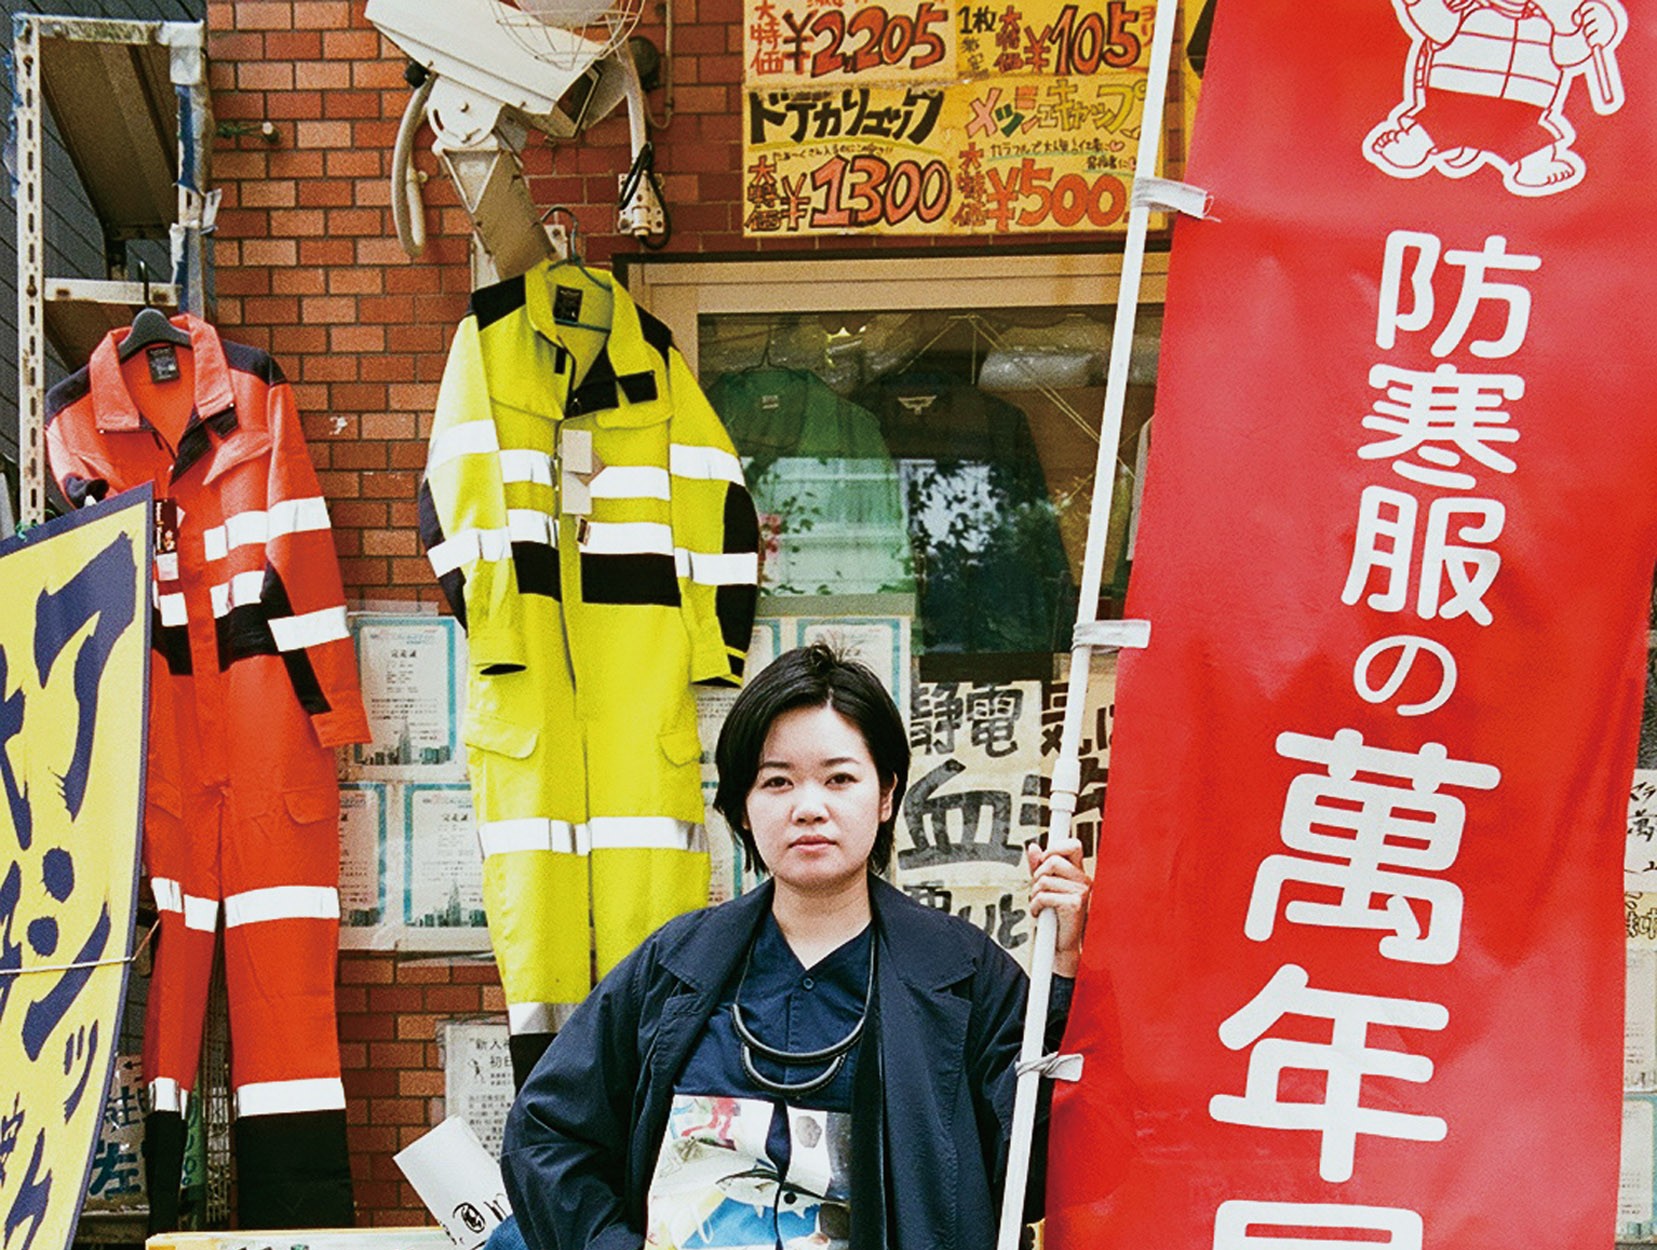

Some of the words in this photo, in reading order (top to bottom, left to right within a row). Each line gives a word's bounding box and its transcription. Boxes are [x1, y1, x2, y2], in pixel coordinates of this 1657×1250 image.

[750, 2, 784, 76] 大特価
[957, 6, 997, 34] 1枚
[1023, 1, 1142, 76] ¥105
[780, 154, 952, 232] ¥1300
